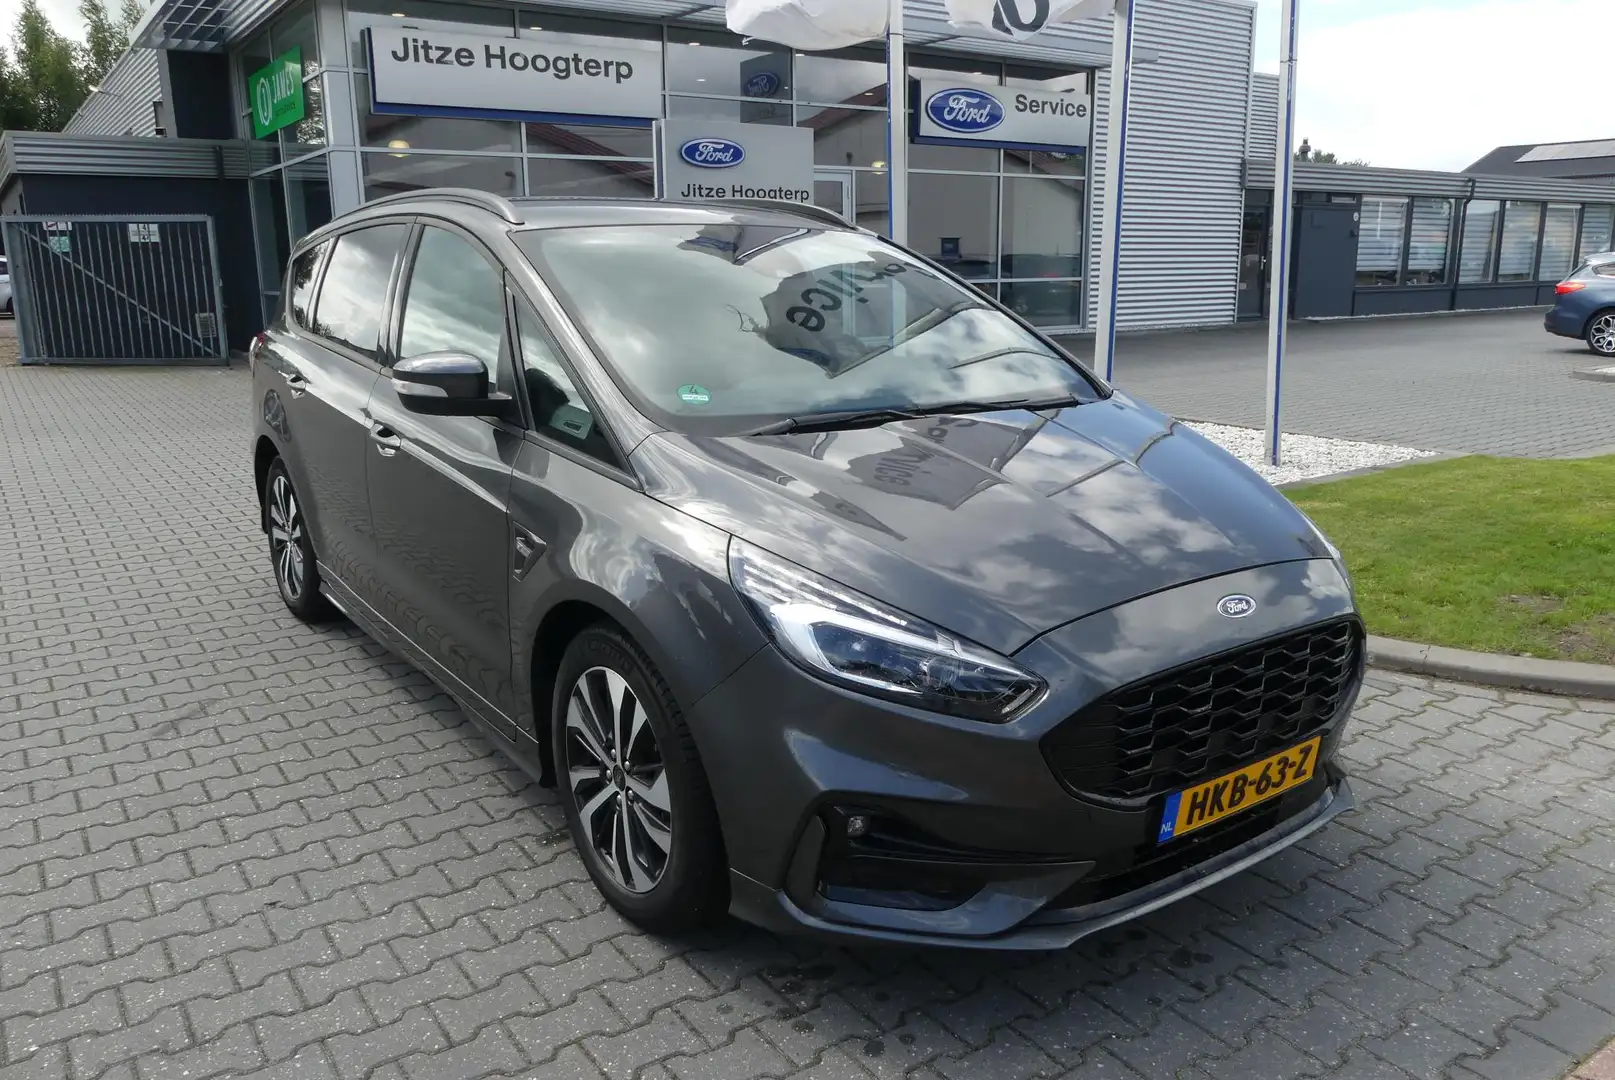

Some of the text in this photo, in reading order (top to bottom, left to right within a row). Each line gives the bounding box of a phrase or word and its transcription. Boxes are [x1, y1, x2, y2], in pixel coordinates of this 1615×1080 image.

[391, 37, 634, 84] Jitze Hoogterp
[272, 66, 295, 104] JAMES
[943, 93, 1087, 123] Ford Service
[695, 142, 733, 162] Ford
[681, 183, 726, 198] Jitze
[1226, 599, 1249, 614] Ford
[1185, 743, 1313, 826] HKB-63-Z
[1160, 822, 1173, 835] NL
